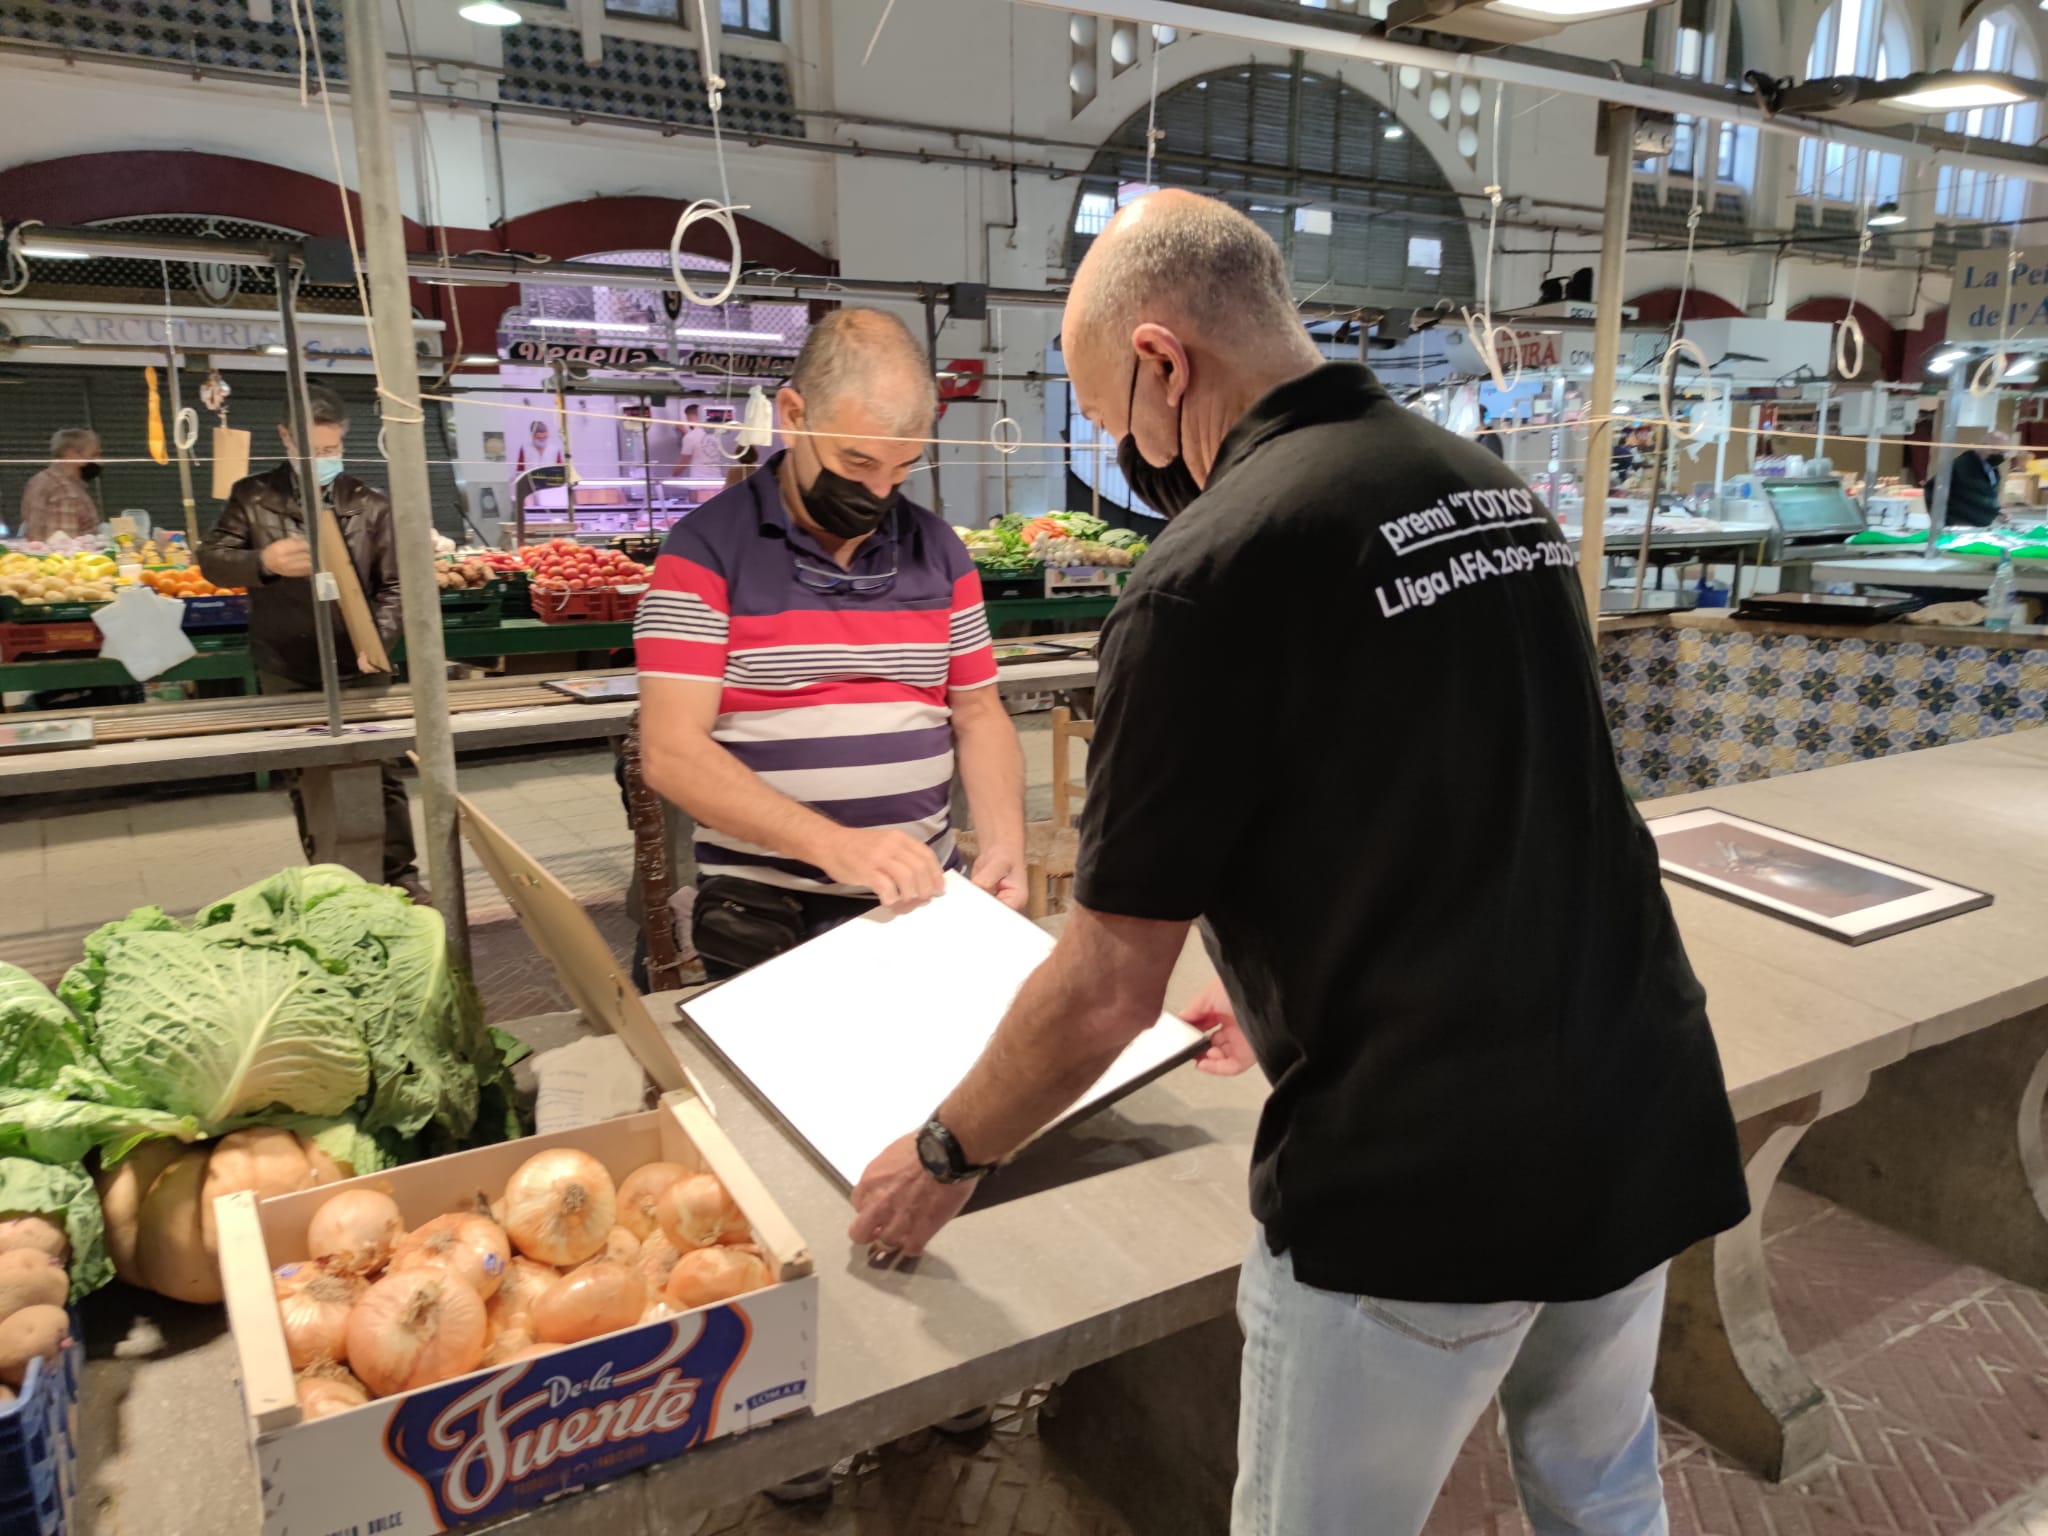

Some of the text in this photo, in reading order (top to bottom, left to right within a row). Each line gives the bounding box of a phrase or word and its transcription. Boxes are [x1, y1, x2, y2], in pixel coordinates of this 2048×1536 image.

[205, 263, 228, 284] 10
[1965, 265, 1999, 289] La
[1969, 303, 2000, 328] de
[1379, 498, 1457, 553] premi
[1375, 570, 1451, 619] Lliga
[1449, 549, 1500, 589] AFA
[543, 1360, 615, 1409] De la
[428, 1358, 703, 1515] Fuente
